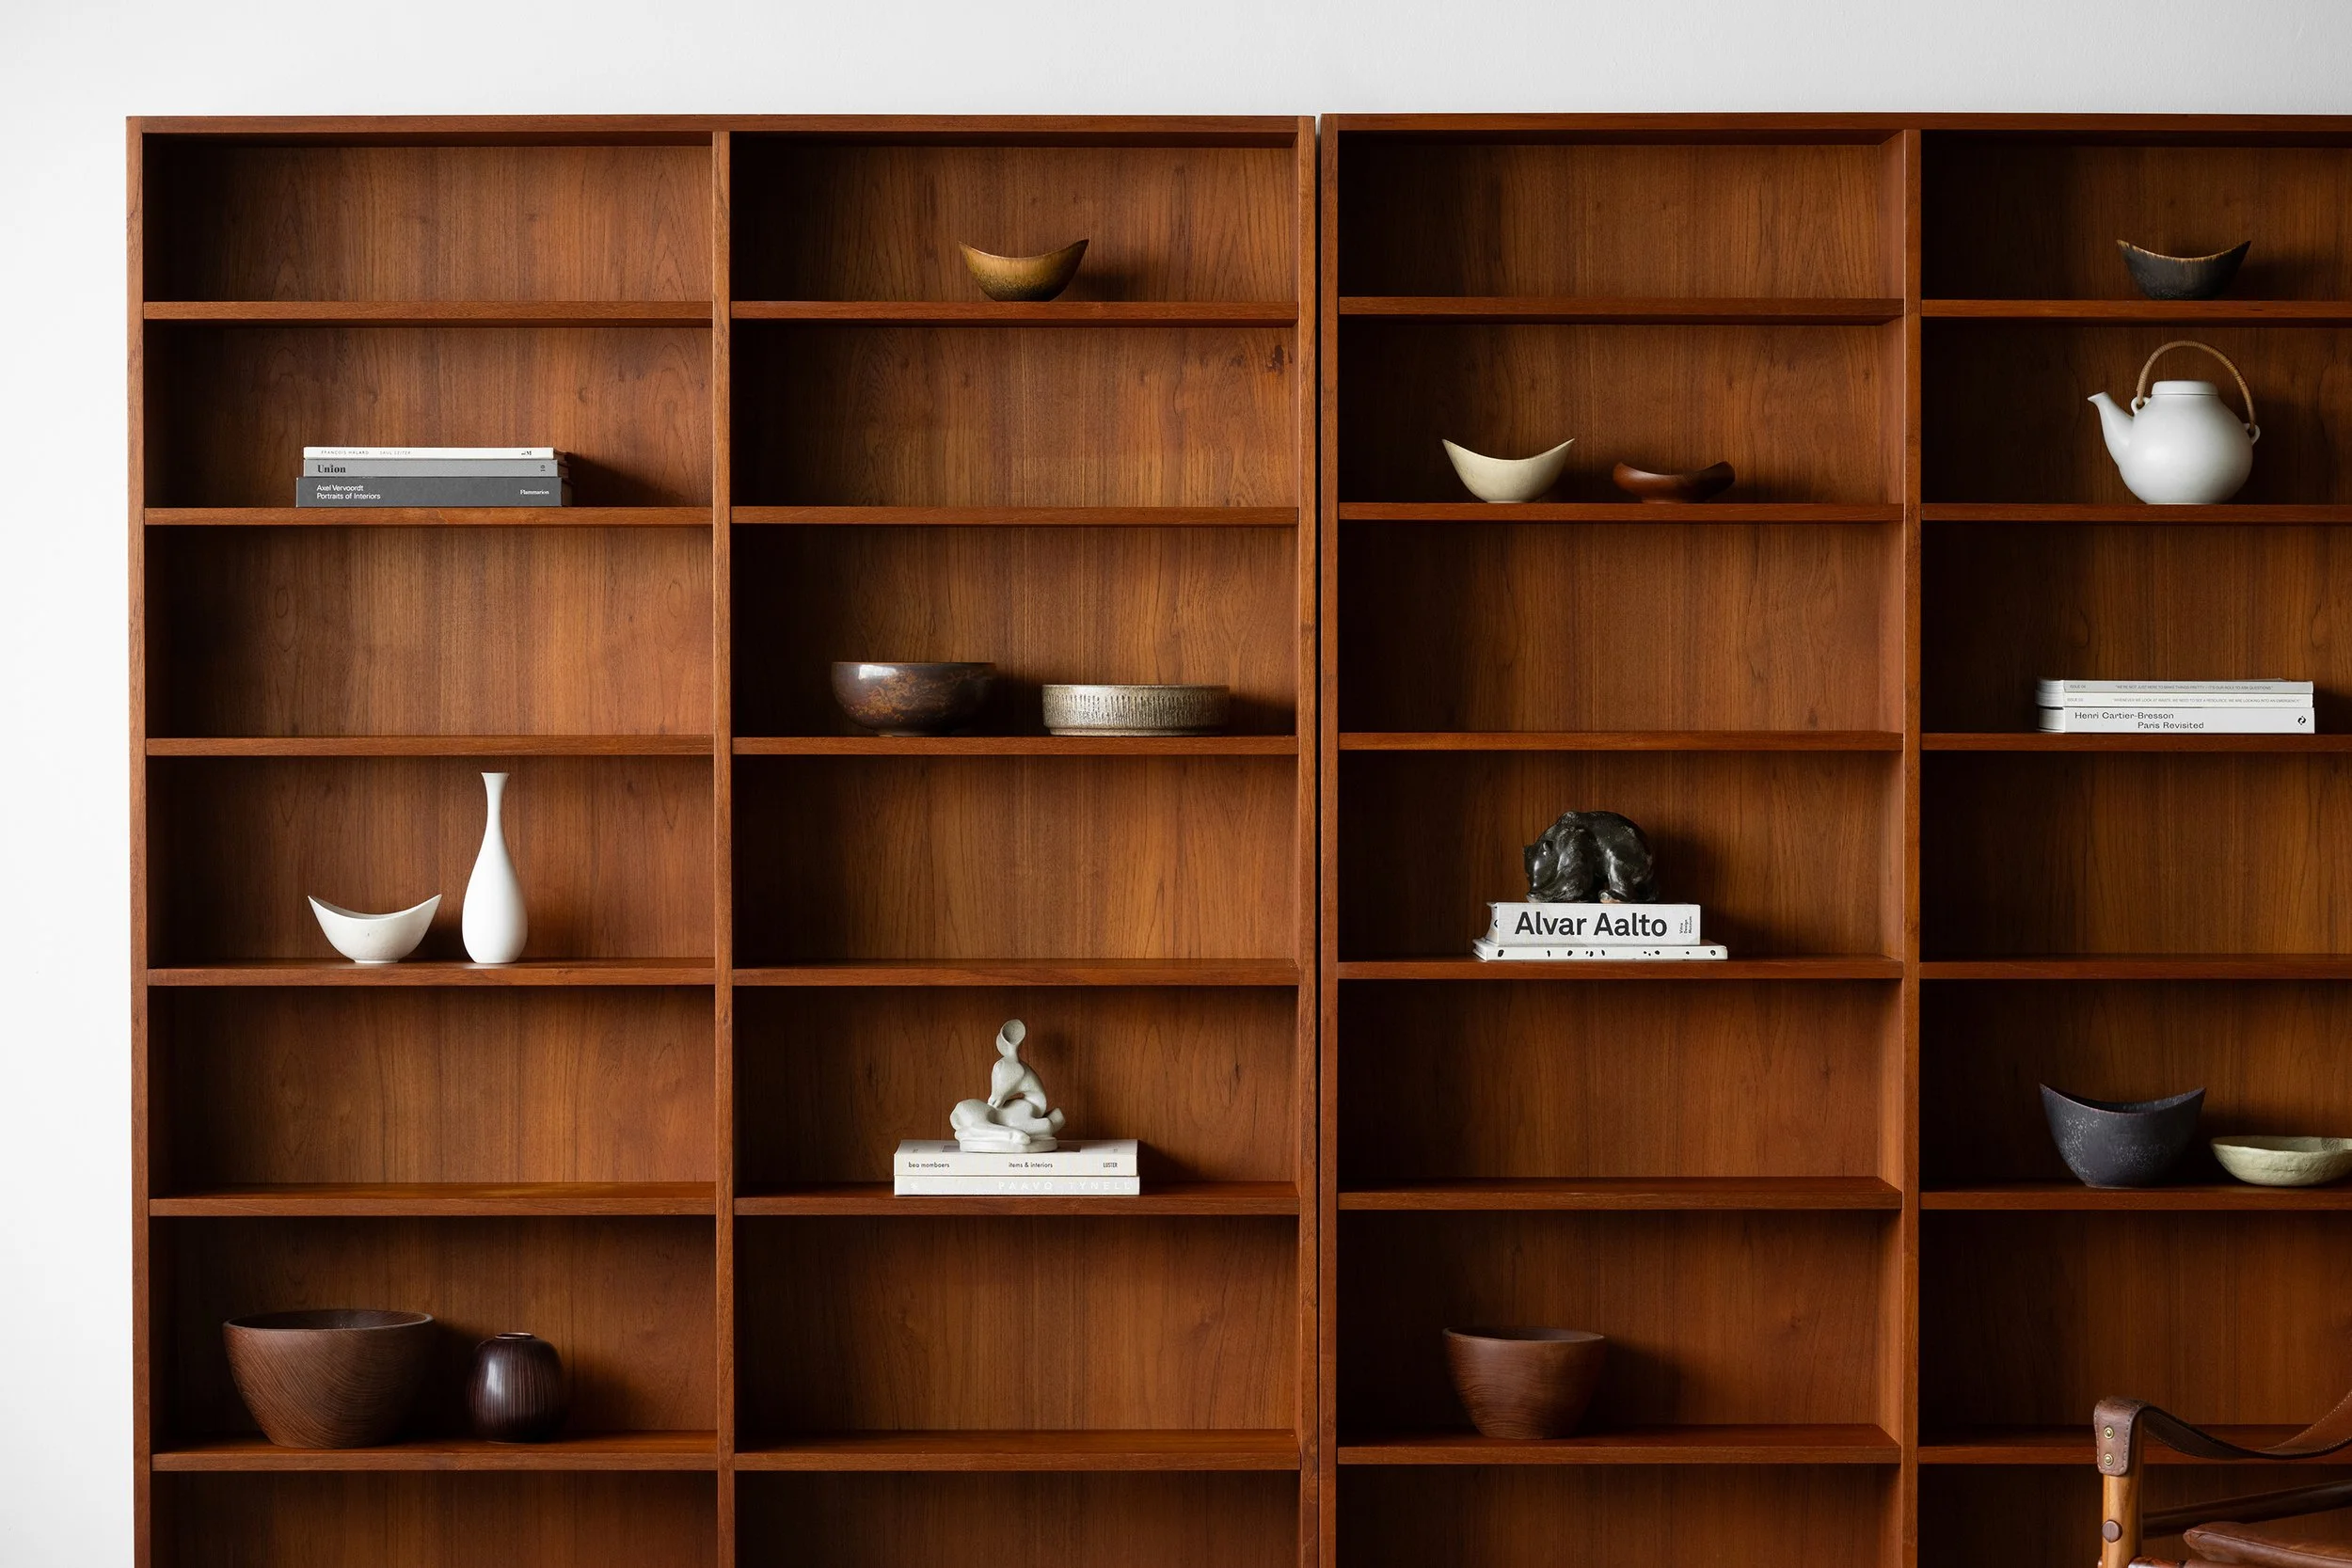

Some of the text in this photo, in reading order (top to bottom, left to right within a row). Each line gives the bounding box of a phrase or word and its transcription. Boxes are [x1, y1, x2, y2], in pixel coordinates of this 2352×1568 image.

[317, 464, 346, 473] Union
[1515, 911, 1668, 936] Alvar Aalto
[998, 1182, 1131, 1190] PAAVO TYNELL
